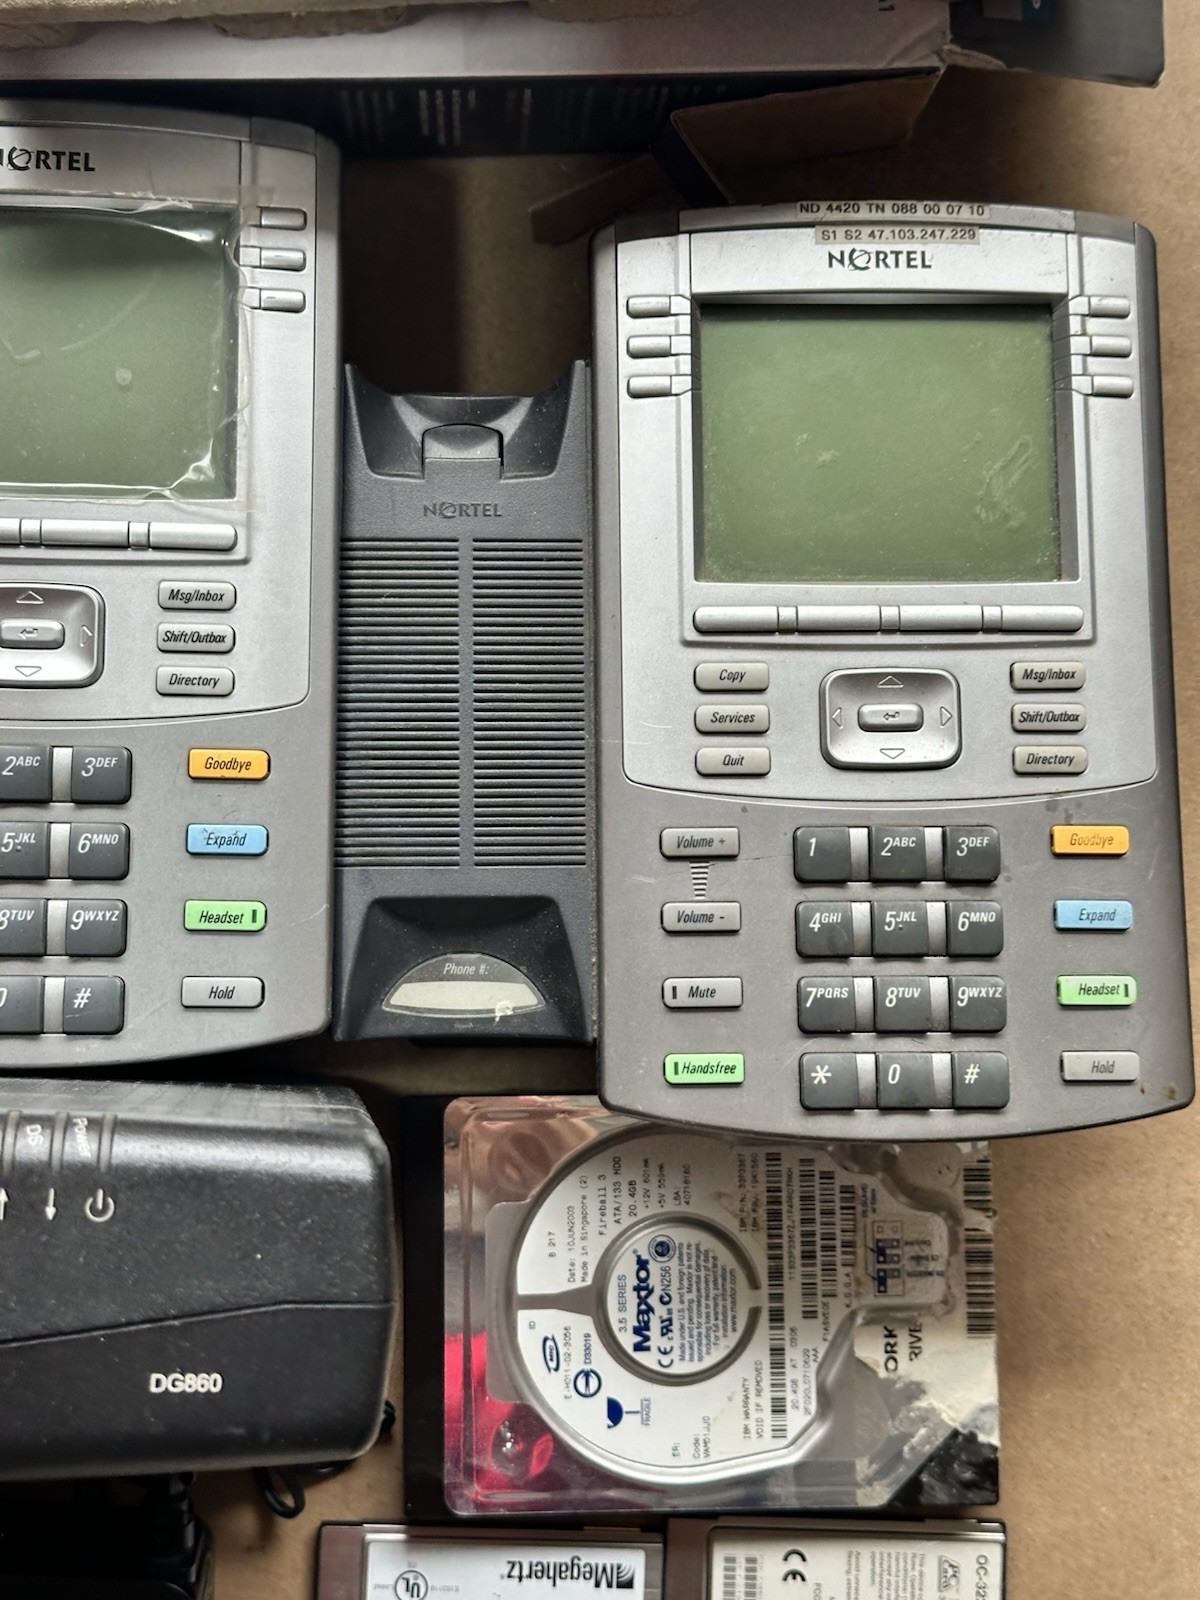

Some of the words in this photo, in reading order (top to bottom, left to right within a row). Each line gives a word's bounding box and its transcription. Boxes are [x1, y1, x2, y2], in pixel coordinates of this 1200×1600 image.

[0, 147, 96, 171] ORTEL
[799, 203, 820, 214] ND
[825, 202, 860, 214] 4420
[867, 203, 885, 214] TN
[891, 203, 918, 215] 088
[923, 204, 941, 215] 00
[946, 204, 962, 216] 07
[969, 205, 985, 217] 10
[821, 229, 837, 241] S1
[844, 229, 862, 241] S2
[868, 228, 976, 241] 47.103.247.229
[827, 248, 933, 271] NORTEL
[422, 501, 503, 519] NORTEL
[168, 588, 225, 604] Msg/Inbox
[162, 630, 227, 644] Shift/Outbox
[168, 673, 221, 690] Directory
[719, 668, 747, 683] Copy
[1022, 668, 1077, 683] Msg/Inbox
[710, 711, 756, 724] Services
[1018, 710, 1081, 724] Shift/Outbox
[204, 756, 252, 773] Goodbye
[722, 754, 745, 766] Quit
[1026, 752, 1076, 767] Directory
[205, 832, 247, 849] Expand
[676, 835, 714, 849] Volume
[808, 837, 817, 856] 1
[1069, 832, 1115, 848] Goodbye
[199, 910, 244, 925] Headset
[676, 910, 715, 923] Volume
[1078, 907, 1117, 923] Expand
[442, 962, 476, 975] Phone
[208, 985, 236, 1001] Hold
[687, 985, 717, 998] Mute
[1078, 983, 1121, 997] Headset
[681, 1060, 737, 1075] Handsfree
[887, 1063, 901, 1085] 0
[1090, 1060, 1116, 1075] Hold
[612, 1156, 622, 1175] HDD
[579, 1175, 589, 1189] (2)
[598, 1173, 607, 1181] 3
[612, 1180, 622, 1224] ATA/133
[628, 1179, 638, 1217] 20.4GB
[579, 1194, 591, 1241] Singapore
[598, 1186, 608, 1236] Fireball
[548, 1230, 557, 1247] 217
[579, 1245, 588, 1255] in
[677, 1242, 685, 1266] patents
[566, 1257, 576, 1283] Date:
[711, 1256, 719, 1269] and
[580, 1260, 589, 1283] Made
[660, 1265, 672, 1290] N256
[616, 1274, 627, 1312] SERIES
[695, 1273, 704, 1318] consequential
[704, 1273, 712, 1301] recovery
[632, 1254, 654, 1352] Maxtor
[528, 1320, 536, 1329] ID
[617, 1317, 627, 1332] 3.5
[695, 1320, 703, 1329] for
[582, 1331, 592, 1364] D33019
[704, 1325, 712, 1354] including
[789, 1358, 798, 1368] AT
[149, 1372, 223, 1393] DG860
[753, 1360, 763, 1397] REMOVED
[742, 1377, 751, 1419] WARRANTY
[754, 1401, 763, 1411] IF
[642, 1396, 652, 1426] FRAGILE
[742, 1423, 752, 1439] IBM
[754, 1417, 764, 1439] VOID
[692, 1433, 702, 1459] Code:
[506, 1555, 614, 1589] Megahertz
[976, 1554, 990, 1600] OC-32
